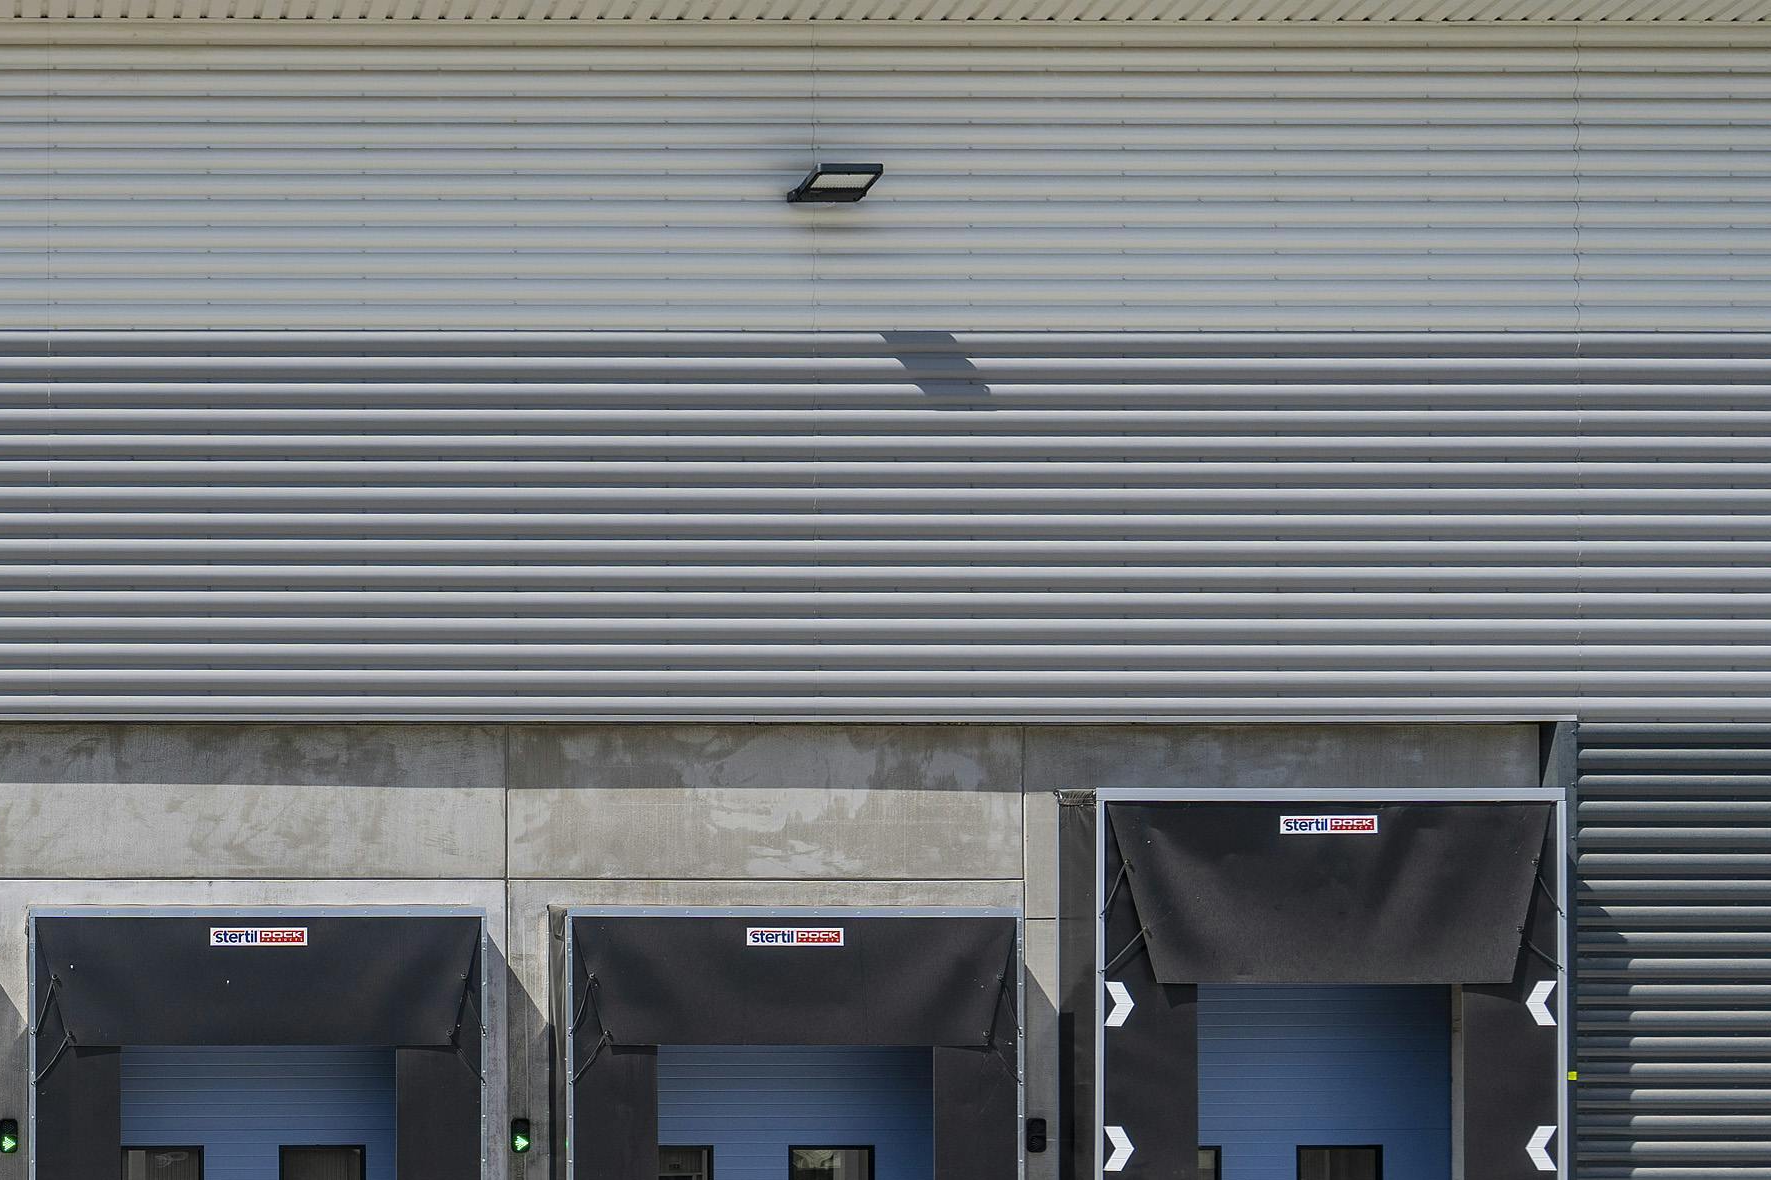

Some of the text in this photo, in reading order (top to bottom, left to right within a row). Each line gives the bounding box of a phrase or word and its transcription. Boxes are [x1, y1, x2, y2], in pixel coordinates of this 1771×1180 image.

[1285, 819, 1328, 831] stertil
[215, 931, 257, 943] stertil
[752, 931, 794, 943] stertil
